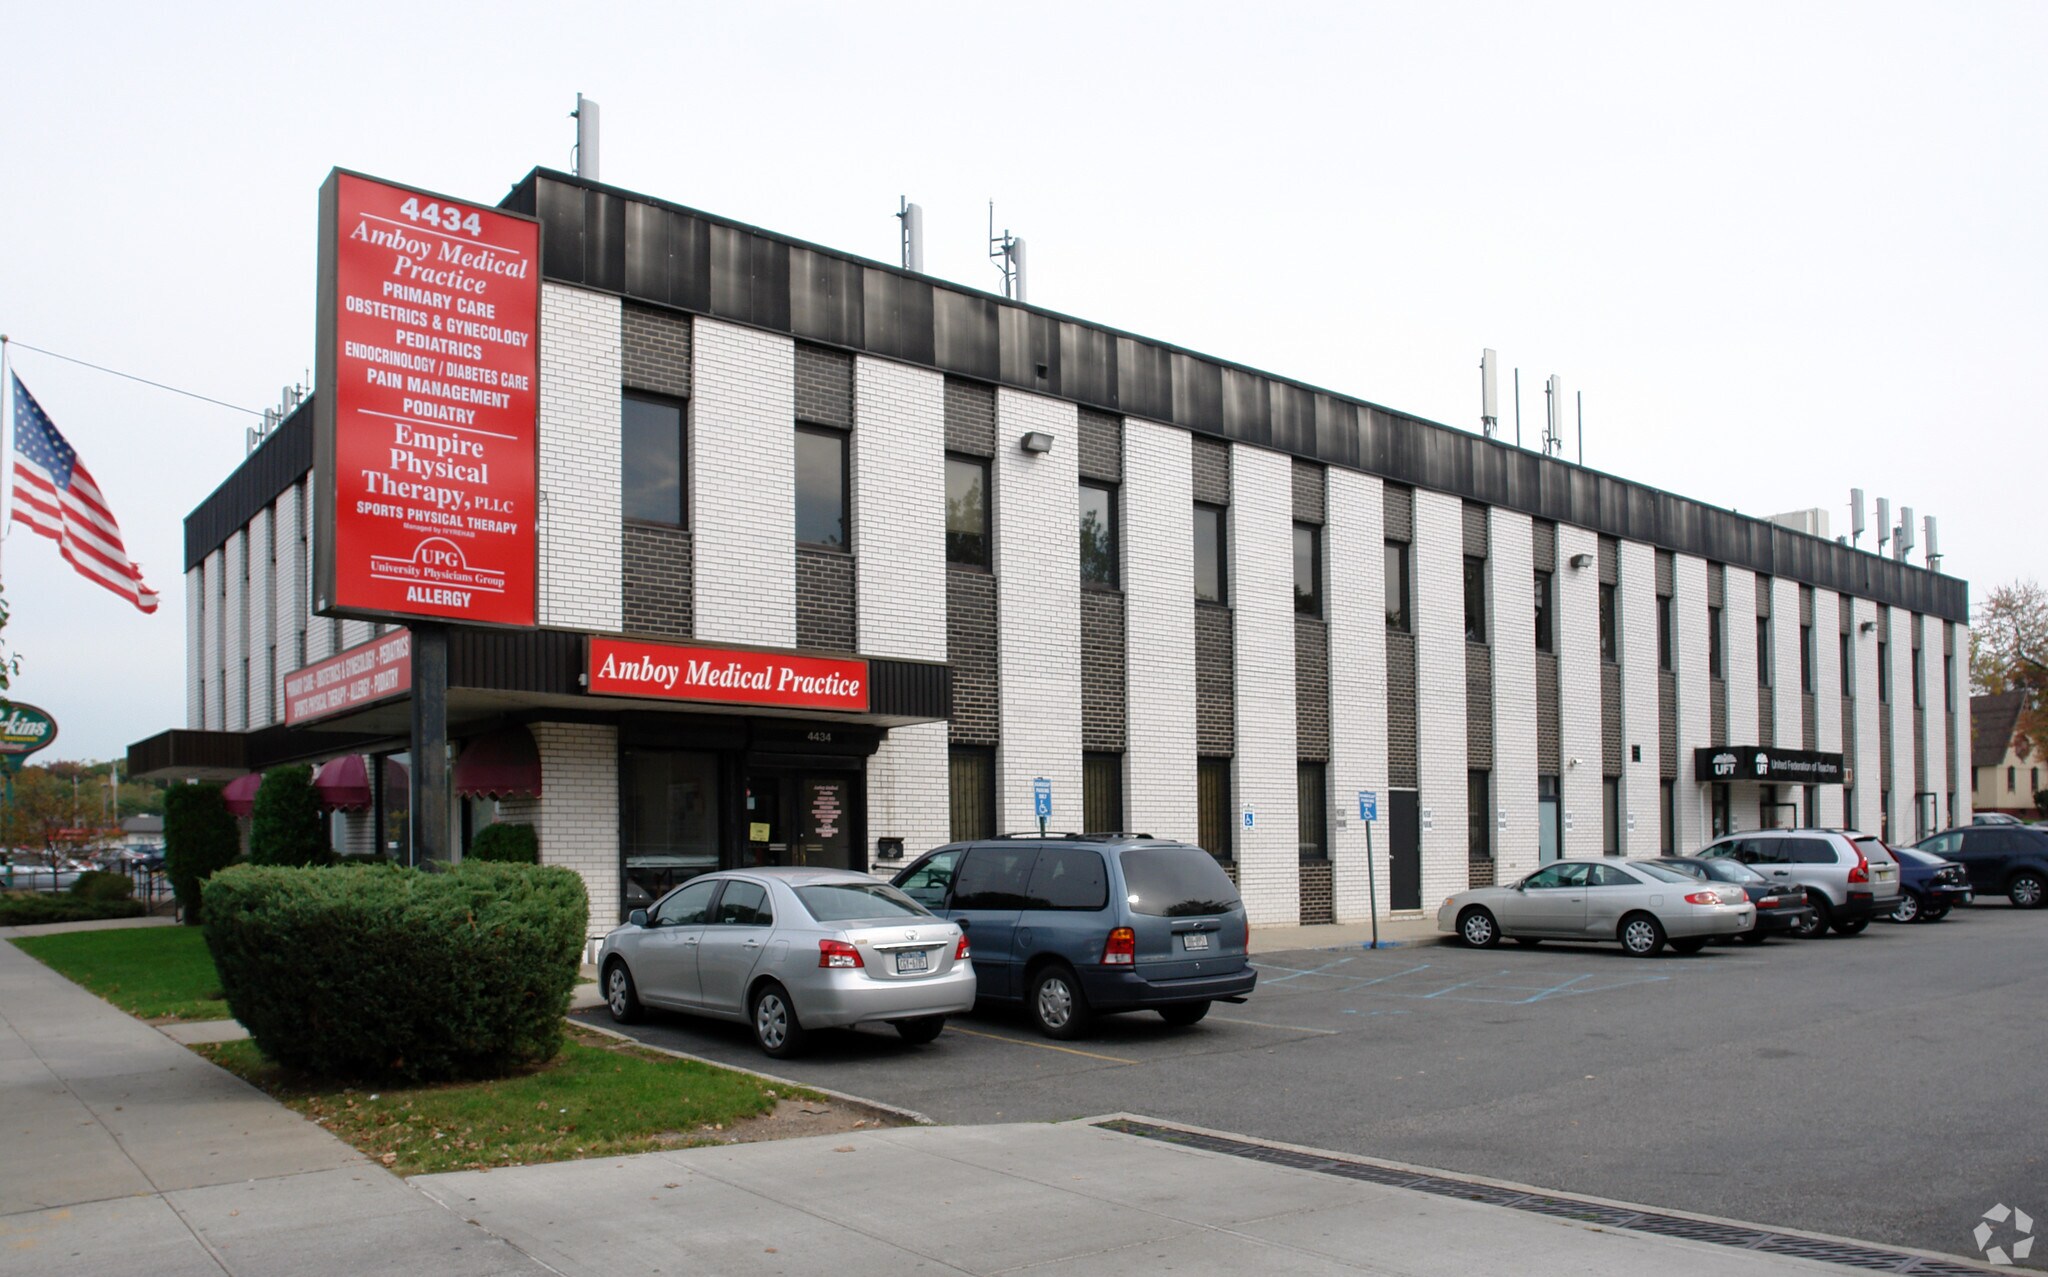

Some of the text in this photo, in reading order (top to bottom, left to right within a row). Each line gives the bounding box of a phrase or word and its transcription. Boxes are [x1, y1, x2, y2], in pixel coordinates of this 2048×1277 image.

[400, 197, 481, 236] 4434
[350, 220, 528, 279] Amboy Medical
[393, 255, 487, 294] Practice
[383, 281, 495, 319] PRIMARY CARE
[346, 295, 528, 347] OBSTETRICS & GYNECOLOGY
[396, 329, 482, 360] PEDIATRICS
[345, 341, 436, 374] ENDOCRINOLOGY
[446, 362, 497, 385] DIABETES
[501, 373, 529, 391] CARE
[367, 368, 510, 409] PAIN MANAGEMENT
[403, 398, 475, 424] PODIATRY
[394, 423, 484, 458] Empire
[390, 448, 488, 484] Physical
[361, 470, 514, 514] Therapy, PLLC
[357, 501, 518, 535] SPORTS PHYSICAL THERAPY
[370, 561, 505, 587] University Physicians Group
[421, 549, 458, 567] UPG
[407, 586, 472, 608] ALLERGY
[598, 653, 860, 697] Amboy Medical Practice
[807, 731, 832, 743] 4434
[1714, 763, 1736, 775] UFT
[1756, 763, 1768, 775] UFT
